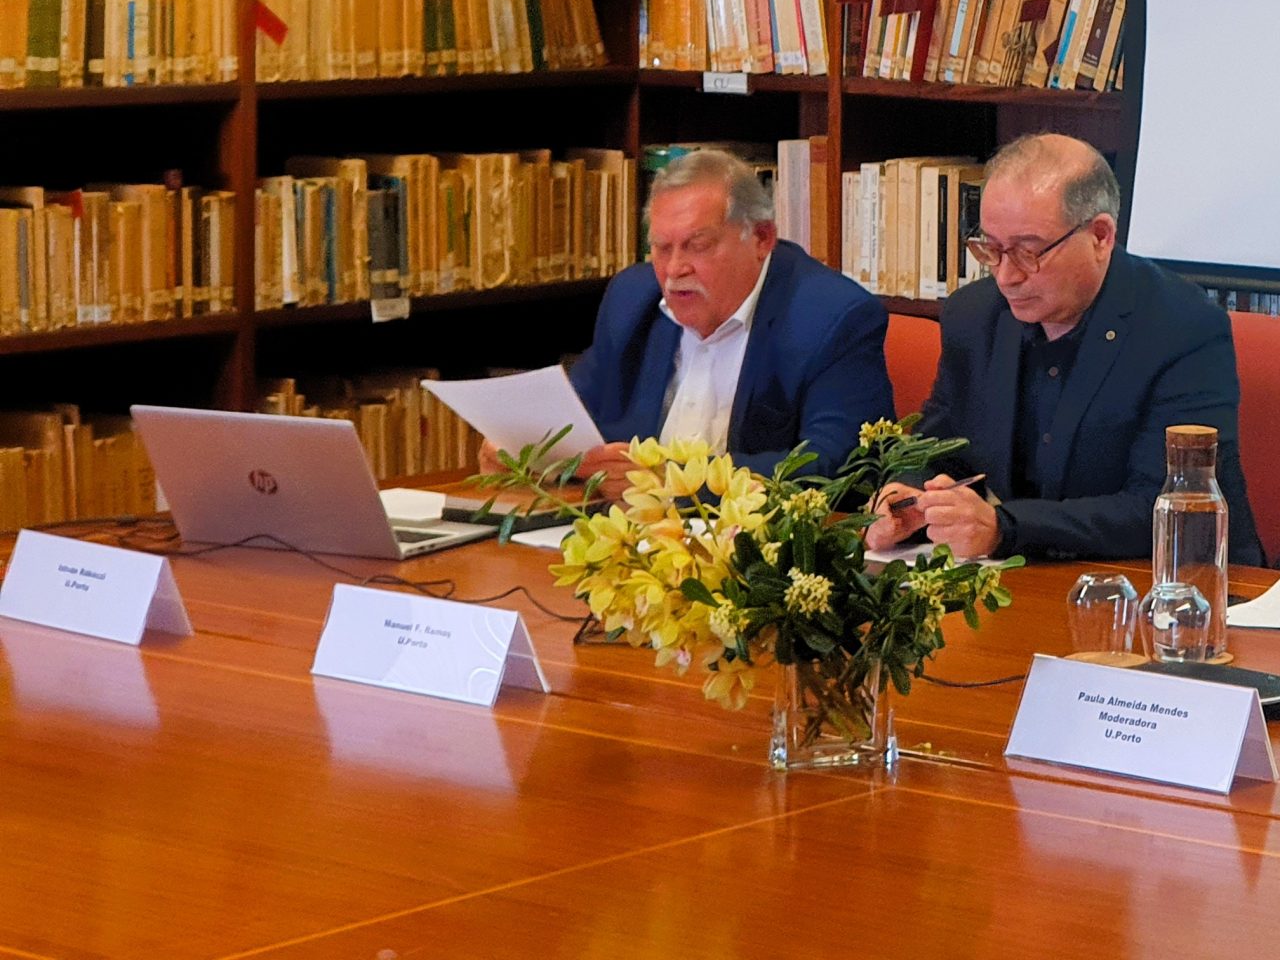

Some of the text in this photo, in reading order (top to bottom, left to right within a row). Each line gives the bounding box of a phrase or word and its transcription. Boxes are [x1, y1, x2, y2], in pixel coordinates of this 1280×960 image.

[249, 470, 278, 495] hp
[384, 618, 413, 632] Manuel
[424, 625, 452, 639] Ramos
[397, 635, 428, 649] U.Porto
[1078, 691, 1189, 718] Paula Almeida Mendes
[1098, 711, 1157, 730] Moderadora
[1104, 729, 1142, 744] U.Porto
